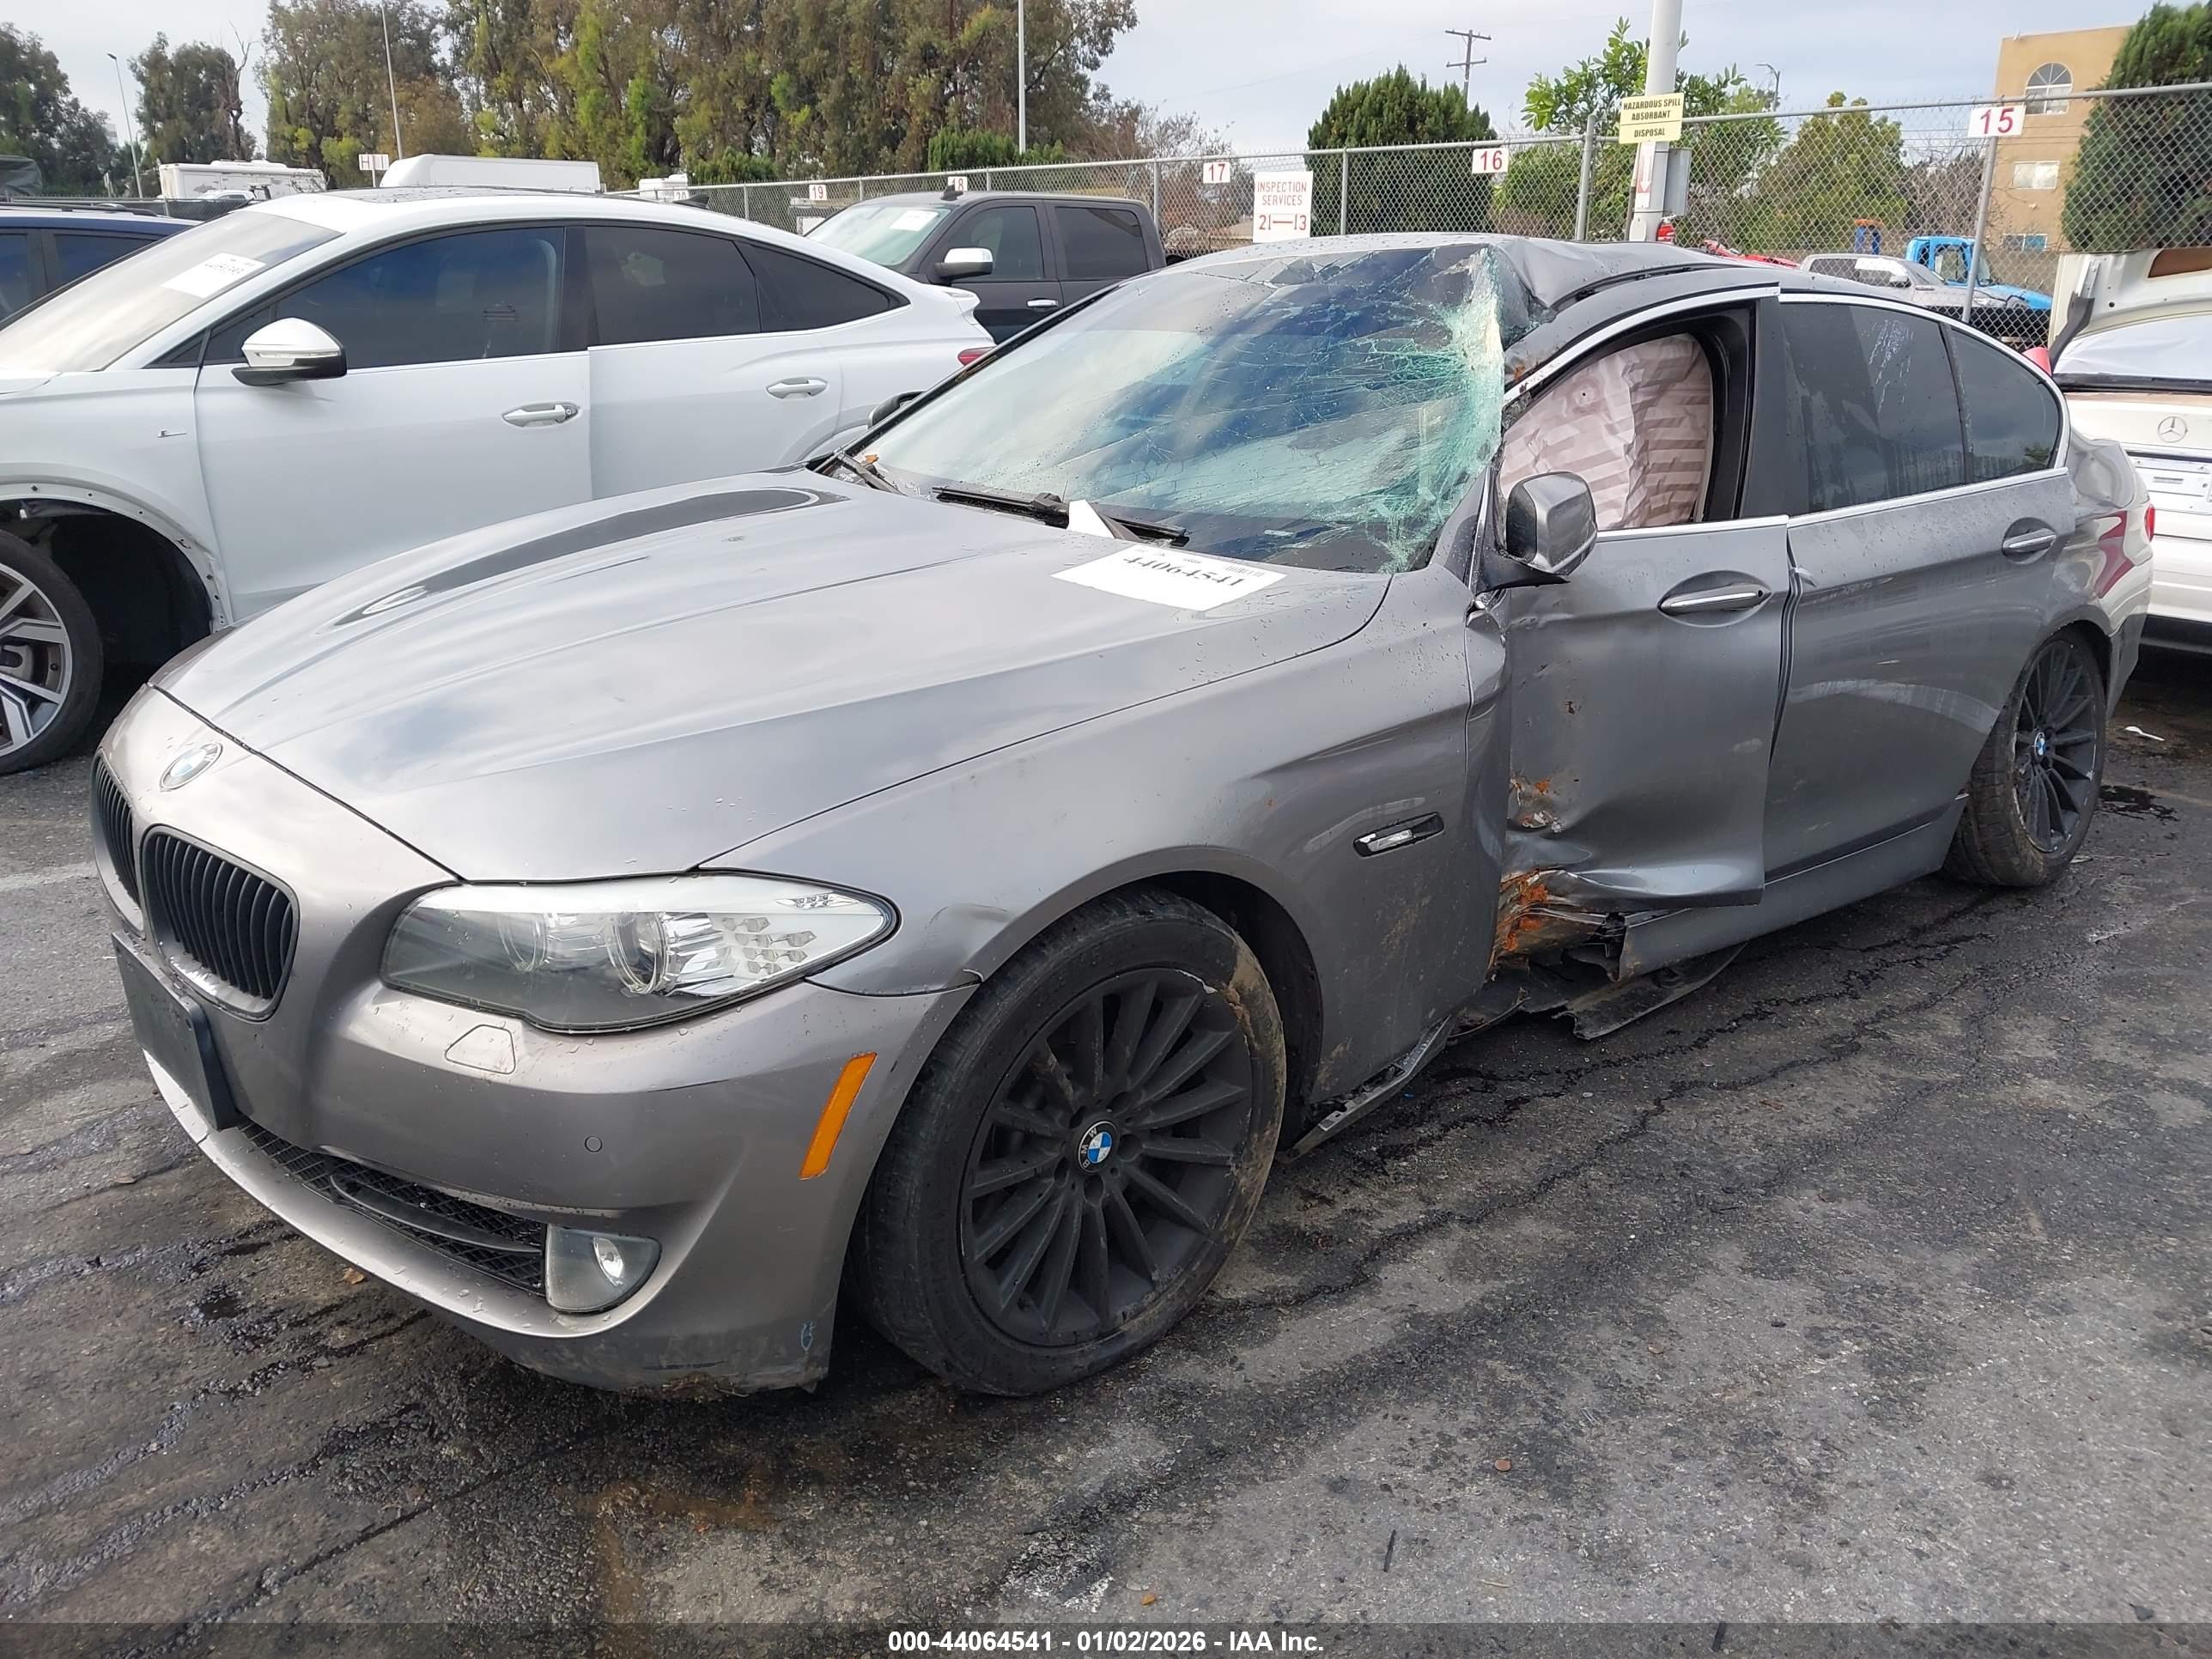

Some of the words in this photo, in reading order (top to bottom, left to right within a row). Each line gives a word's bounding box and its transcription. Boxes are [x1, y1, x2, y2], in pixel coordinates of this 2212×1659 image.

[1623, 100, 1662, 111] HAZARDOUS
[1663, 98, 1681, 107] SPILL
[1631, 110, 1671, 121] ABSORBANT
[1980, 107, 2014, 135] 15
[1633, 127, 1666, 138] DISPOSAL
[1480, 149, 1503, 171] 16
[1208, 163, 1225, 181] 17
[811, 185, 823, 200] 19
[1257, 181, 1307, 193] INSPECTION
[1261, 194, 1303, 206] SERVICES
[1122, 556, 1245, 586] 44064541
